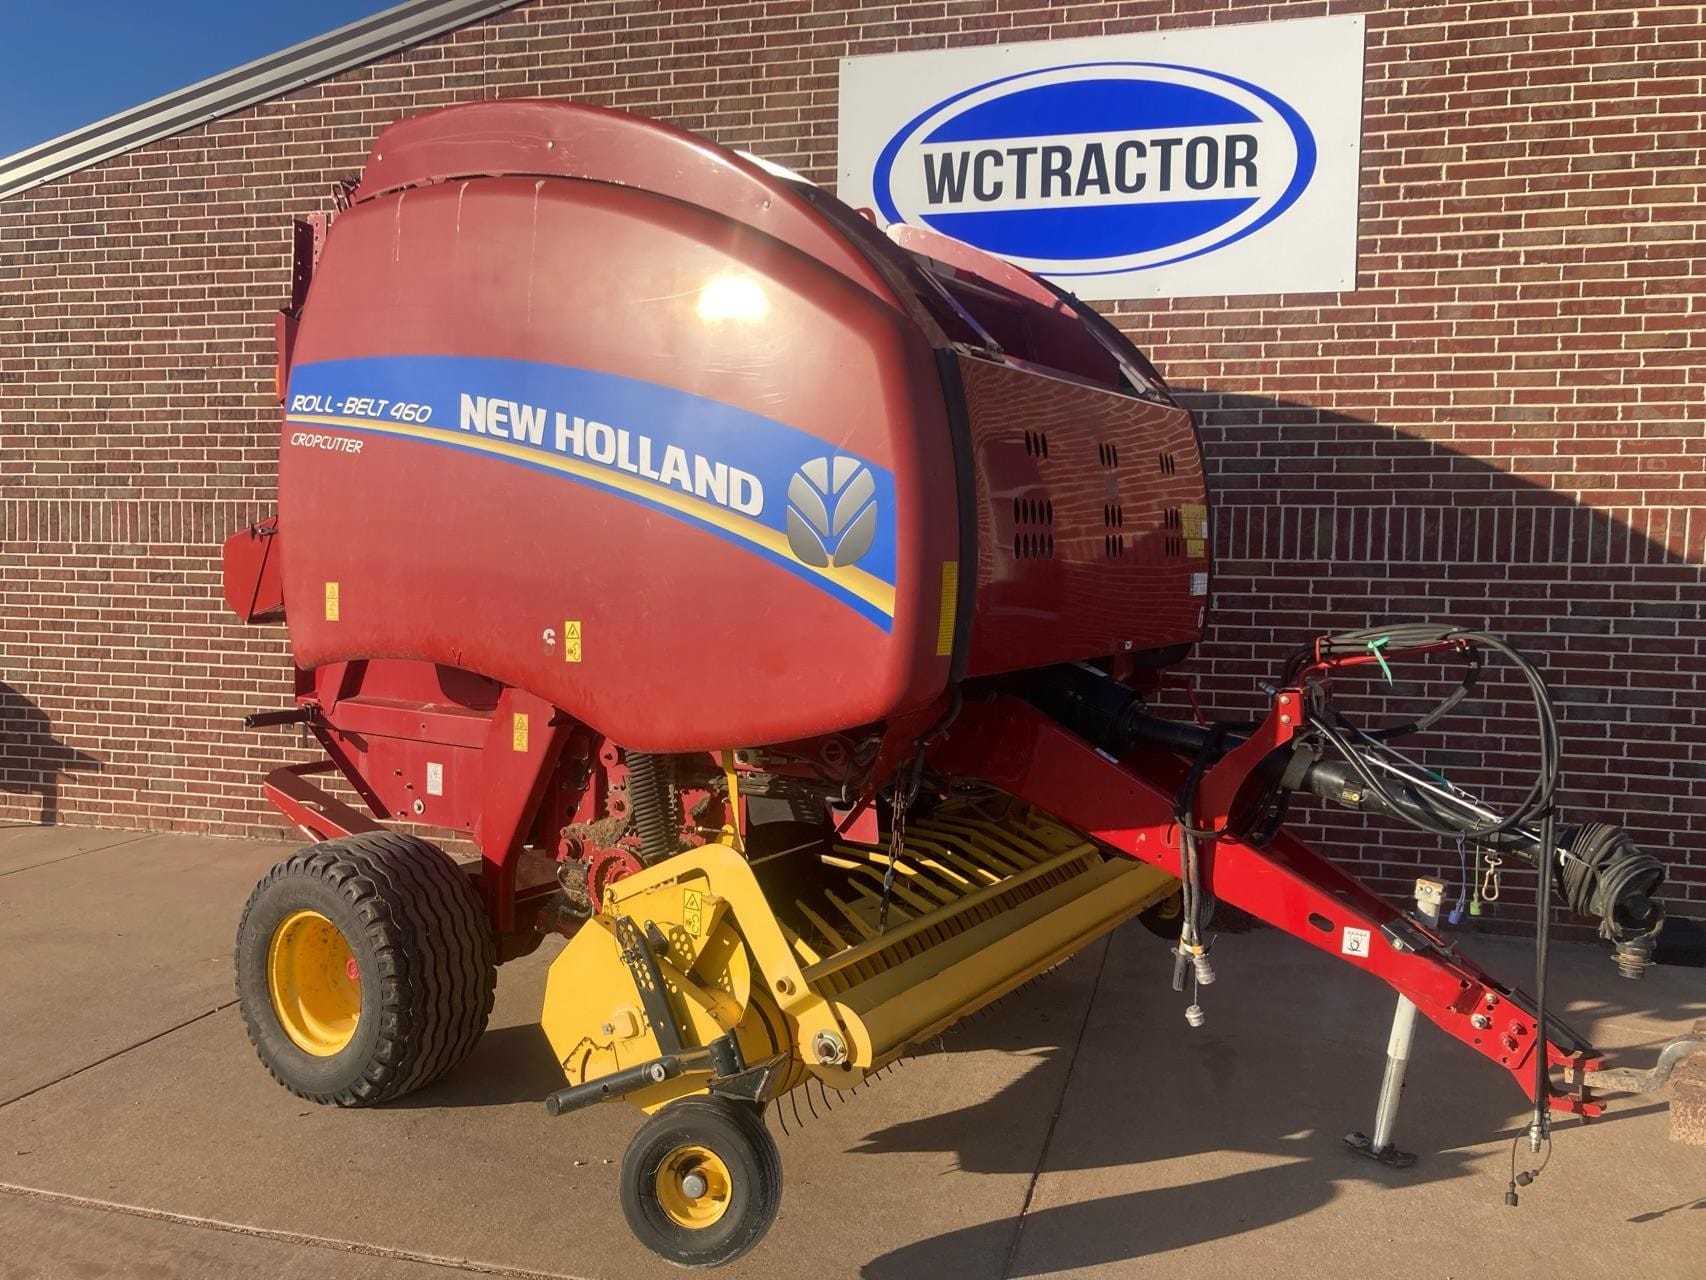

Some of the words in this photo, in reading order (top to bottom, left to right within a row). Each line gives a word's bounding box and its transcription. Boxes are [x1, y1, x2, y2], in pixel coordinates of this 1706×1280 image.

[923, 134, 1258, 205] WCTRACTOR
[390, 402, 433, 423] 460
[290, 432, 364, 454] CROPCUTTER
[460, 393, 547, 445] NEW
[555, 412, 765, 517] HOLLAND
